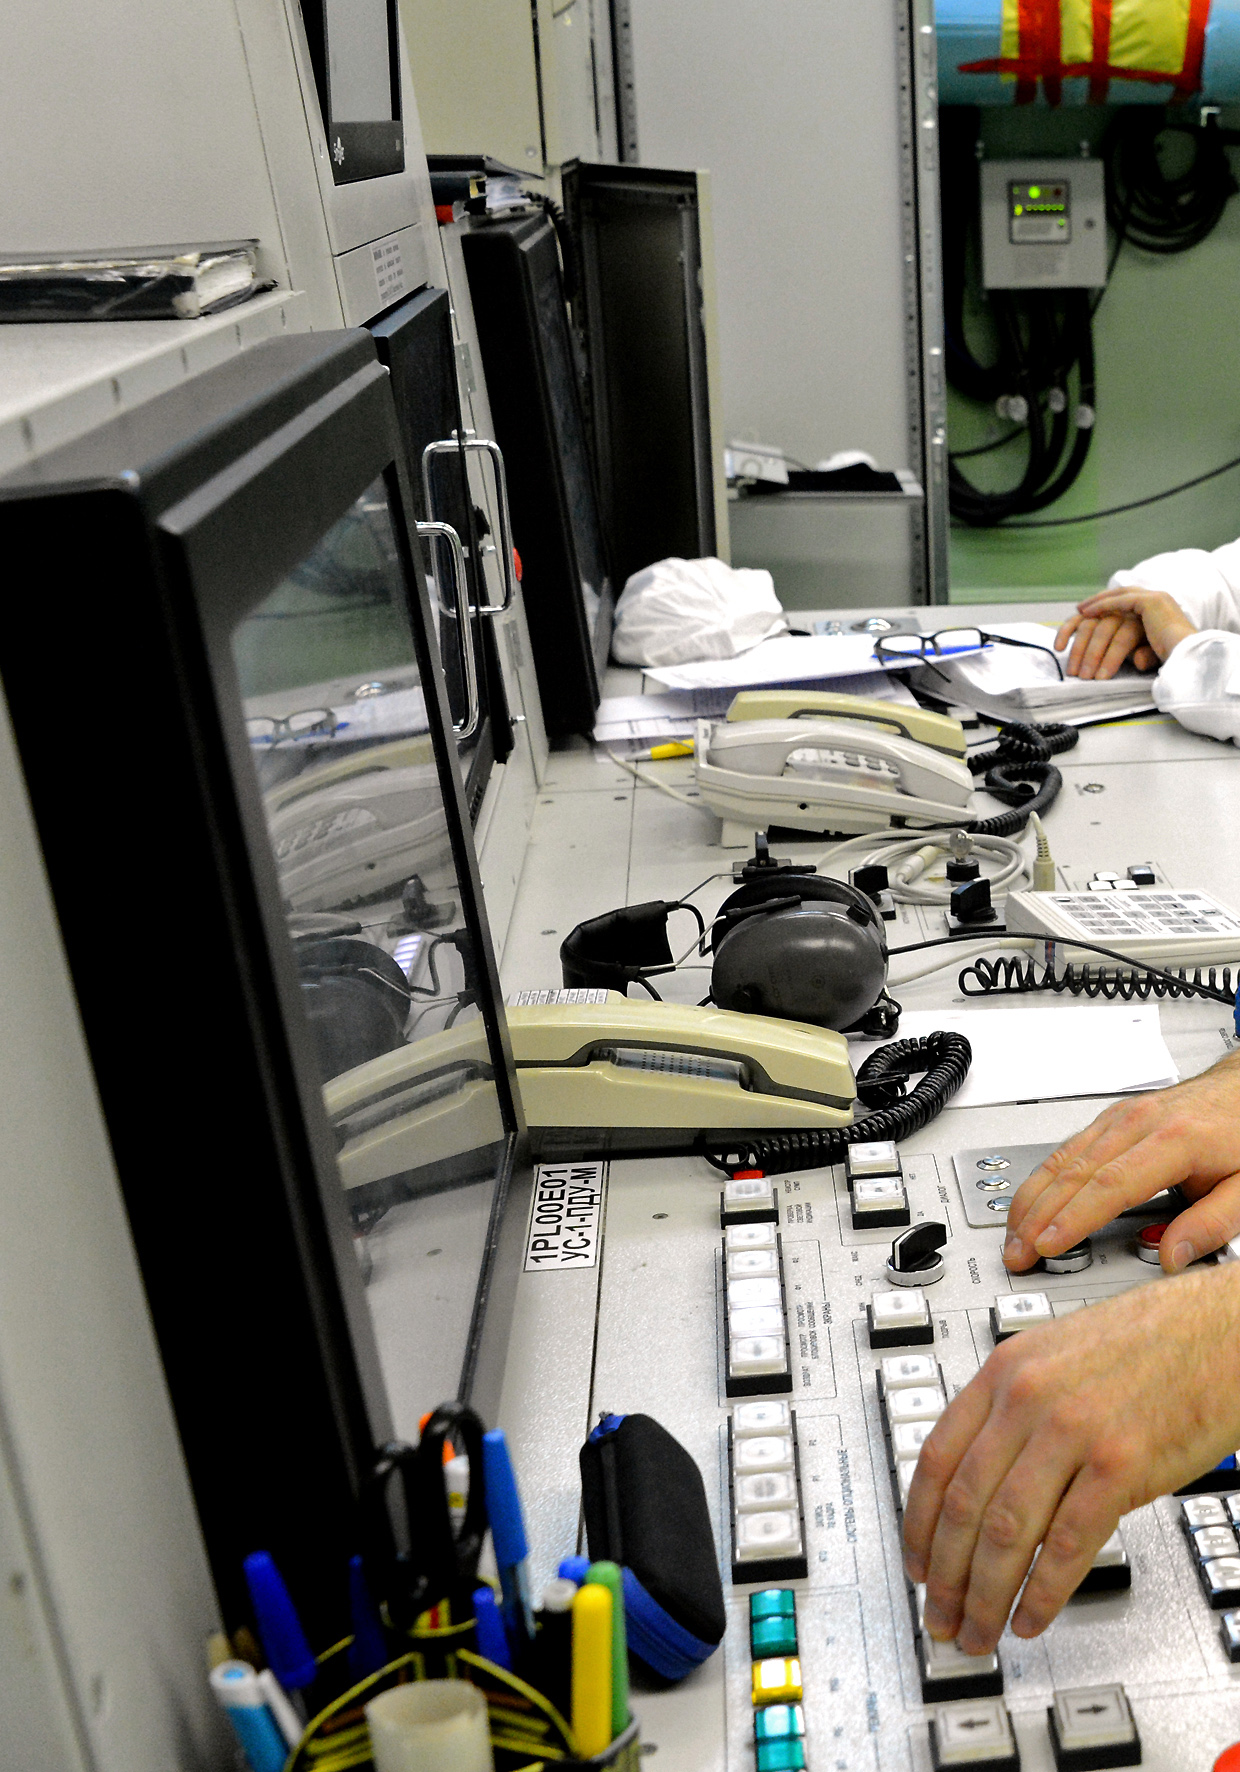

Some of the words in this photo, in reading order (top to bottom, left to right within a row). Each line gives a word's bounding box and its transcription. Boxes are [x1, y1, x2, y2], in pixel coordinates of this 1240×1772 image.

[936, 1185, 951, 1204] ДИАЛОГ
[529, 1168, 568, 1264] 1PL00E01
[561, 1166, 601, 1262] УС-1-ПДУ-М
[795, 1202, 805, 1224] СВЕТОВОЙ
[966, 1257, 982, 1285] СКОРОСТЬ
[821, 1302, 833, 1325] ЭКРАНЫ
[837, 1448, 854, 1507] ОПЦИОНАЛЬНЫЕ
[844, 1508, 858, 1543] СИСТЕМЫ
